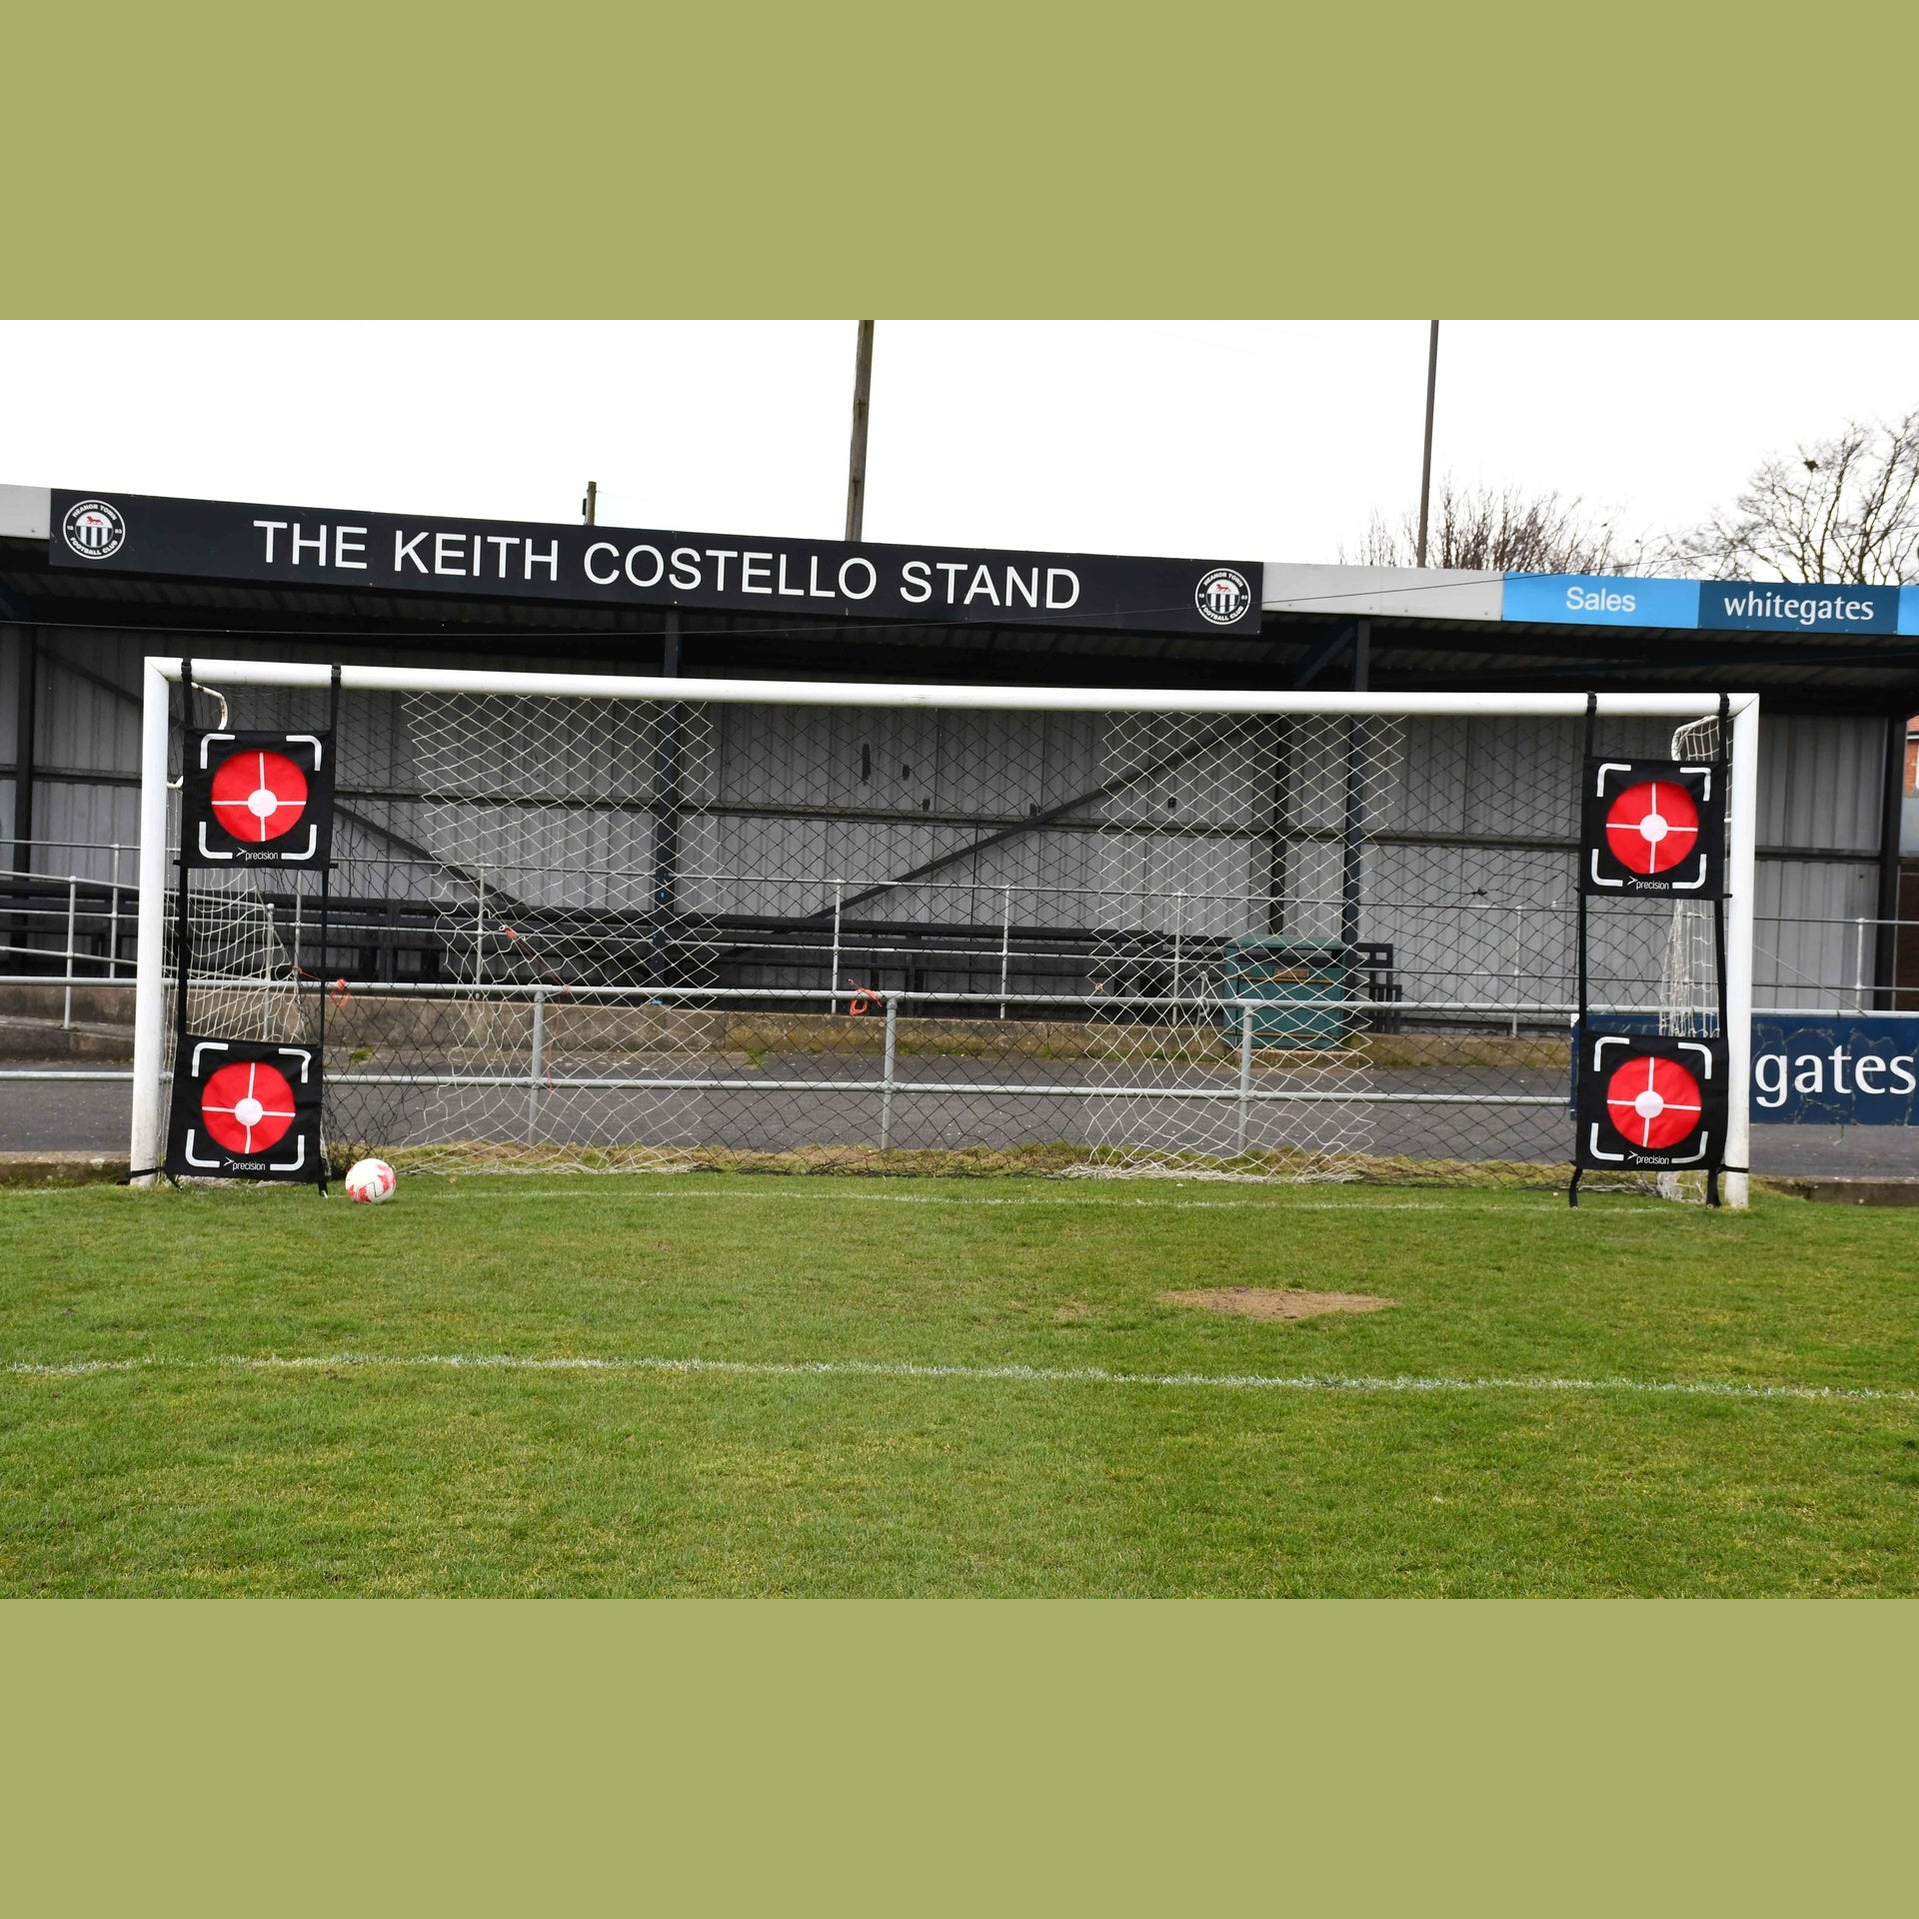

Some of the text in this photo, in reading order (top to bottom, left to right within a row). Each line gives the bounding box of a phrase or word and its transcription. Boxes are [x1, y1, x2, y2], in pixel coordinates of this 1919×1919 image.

[70, 537, 118, 555] FOOTBALL CLUB
[253, 520, 1081, 609] THE KEITH COSTELLO STAND
[1566, 586, 1636, 613] Sales
[1724, 590, 1875, 625] whitegates
[1201, 604, 1229, 621] FOOTBALL
[245, 850, 279, 862] precision
[1635, 880, 1670, 890] precision
[1754, 1044, 1917, 1108] gates
[232, 1162, 266, 1172] precision
[1636, 1155, 1670, 1165] precision
